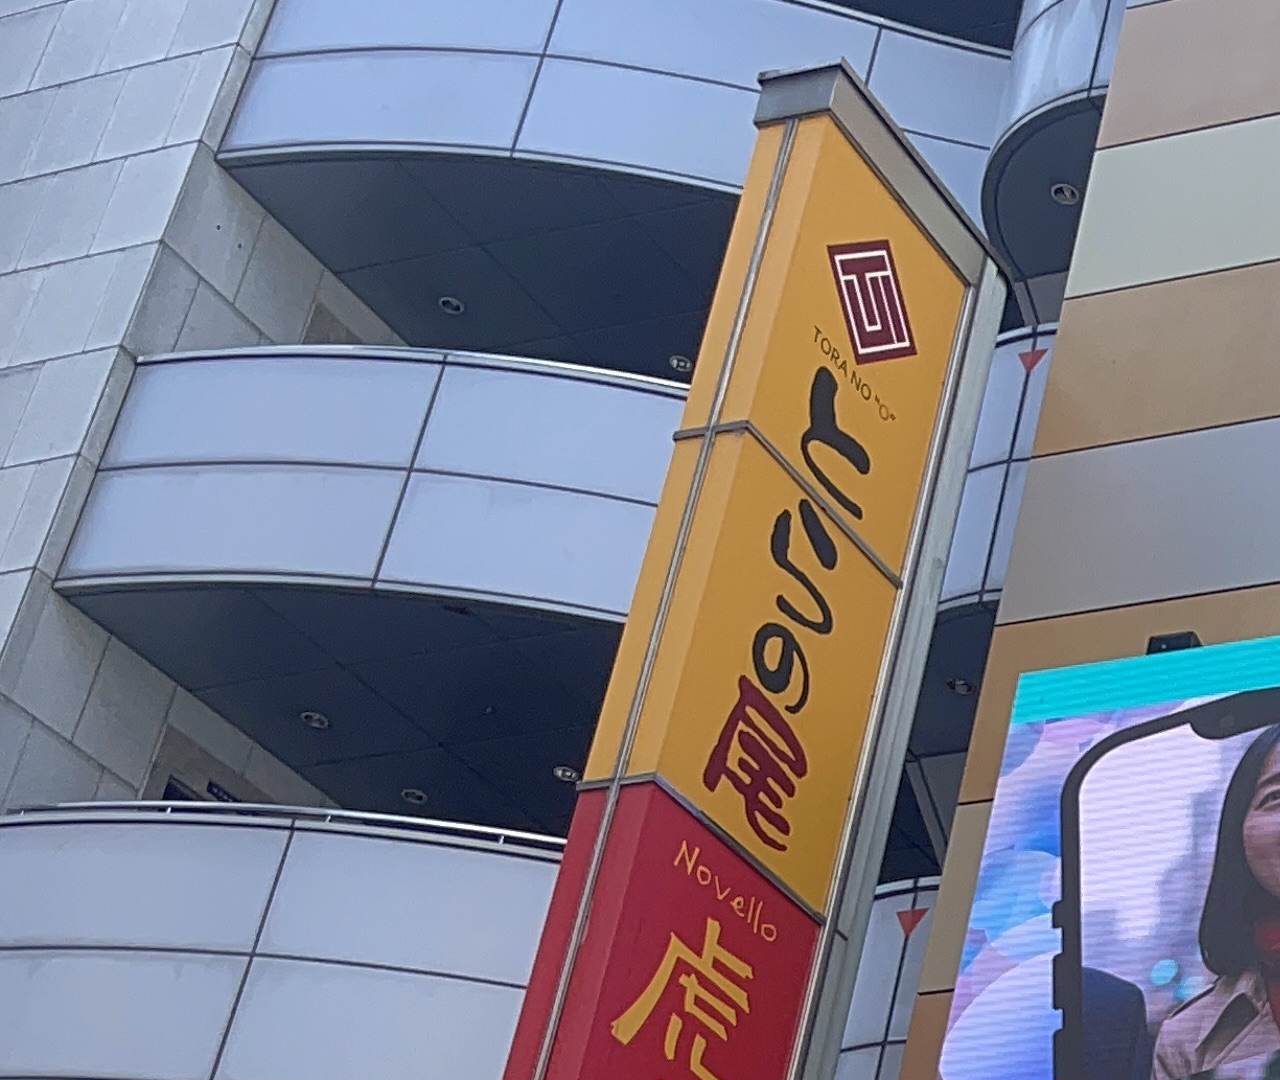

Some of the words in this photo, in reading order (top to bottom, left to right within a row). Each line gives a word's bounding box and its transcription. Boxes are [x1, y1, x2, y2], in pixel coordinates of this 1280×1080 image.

[813, 325, 848, 378] TORA
[851, 370, 871, 400] NO
[673, 840, 778, 942] Novello
